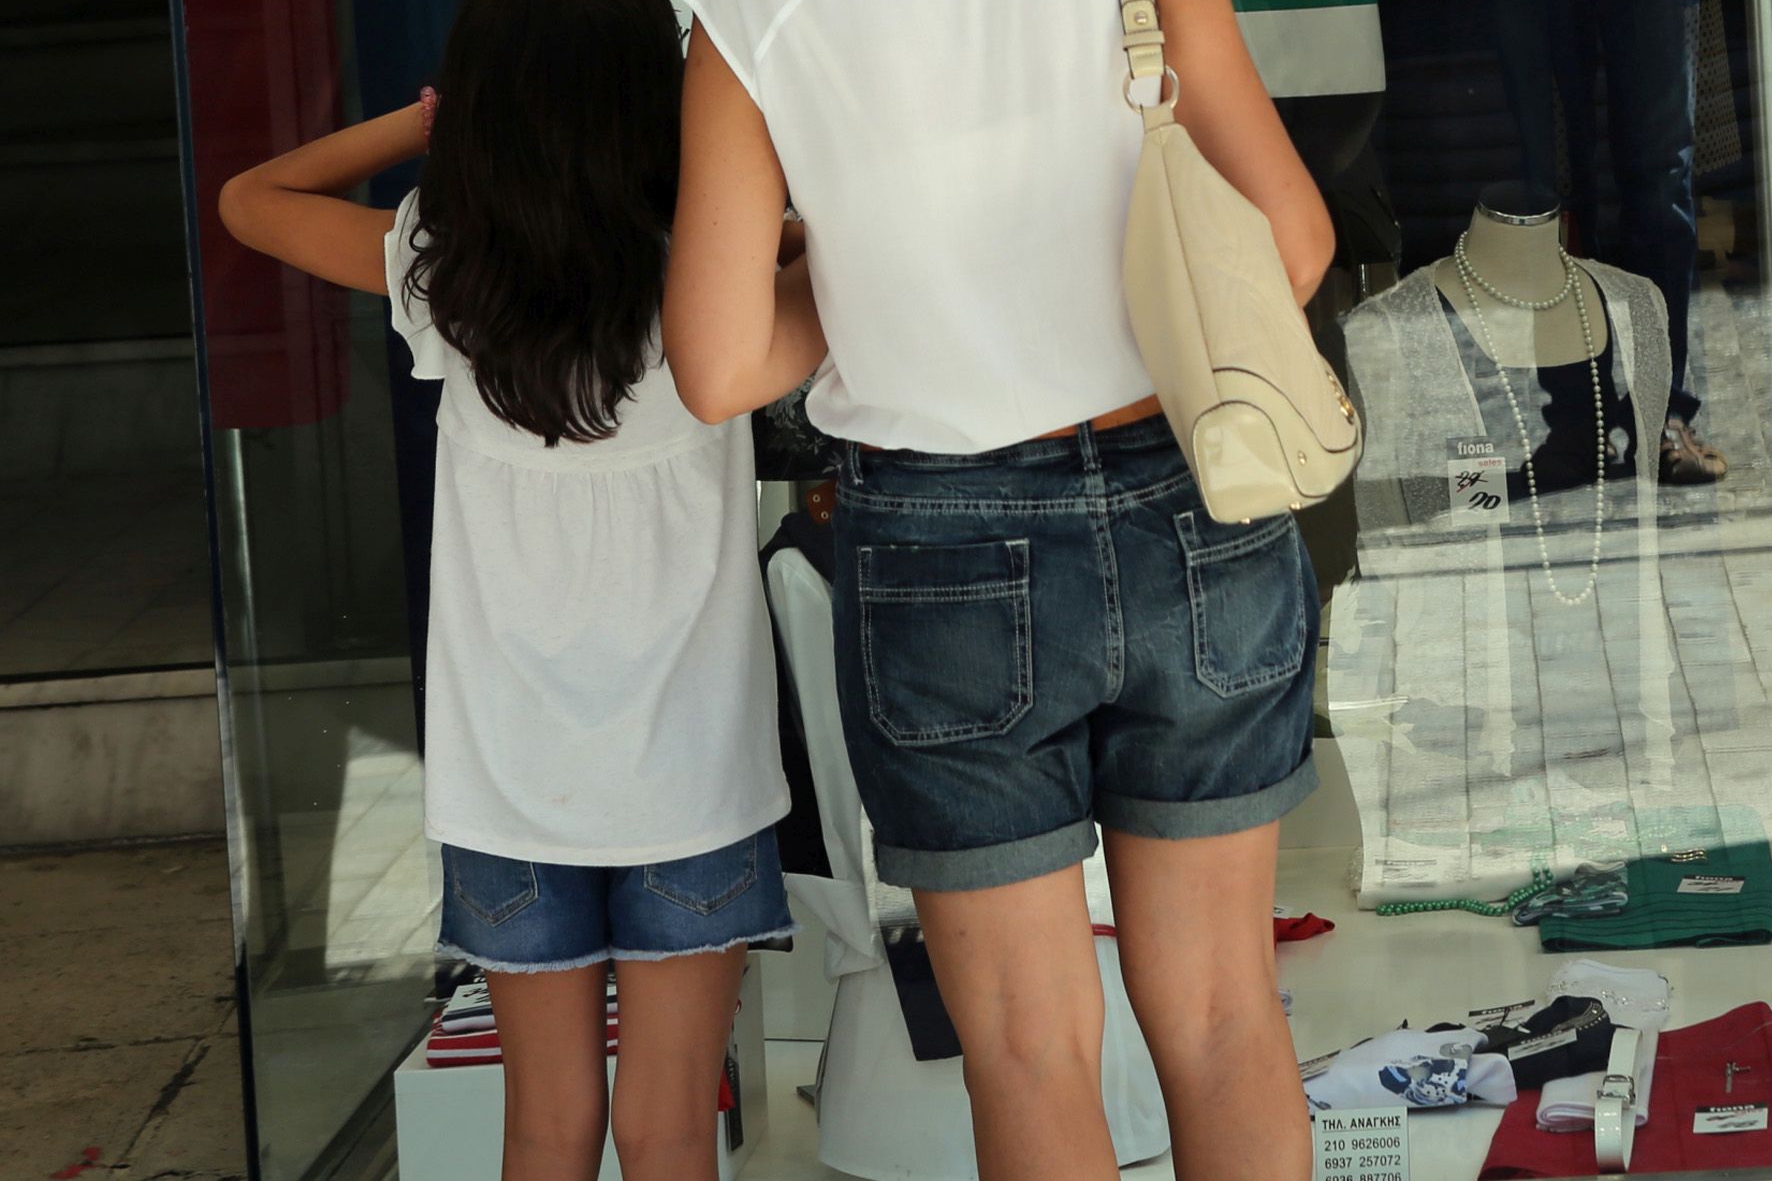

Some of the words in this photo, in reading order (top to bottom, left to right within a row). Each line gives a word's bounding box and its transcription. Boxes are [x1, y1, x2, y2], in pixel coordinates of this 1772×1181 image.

[1457, 441, 1494, 455] fiona
[1322, 1118, 1347, 1131] ΤΗΛ.
[1350, 1116, 1401, 1129] ΑΝΑΓΚΗΣ
[1324, 1140, 1346, 1152] 210
[1352, 1137, 1401, 1150] 9626006
[1325, 1157, 1353, 1170] 6937
[1360, 1155, 1401, 1168] 257072
